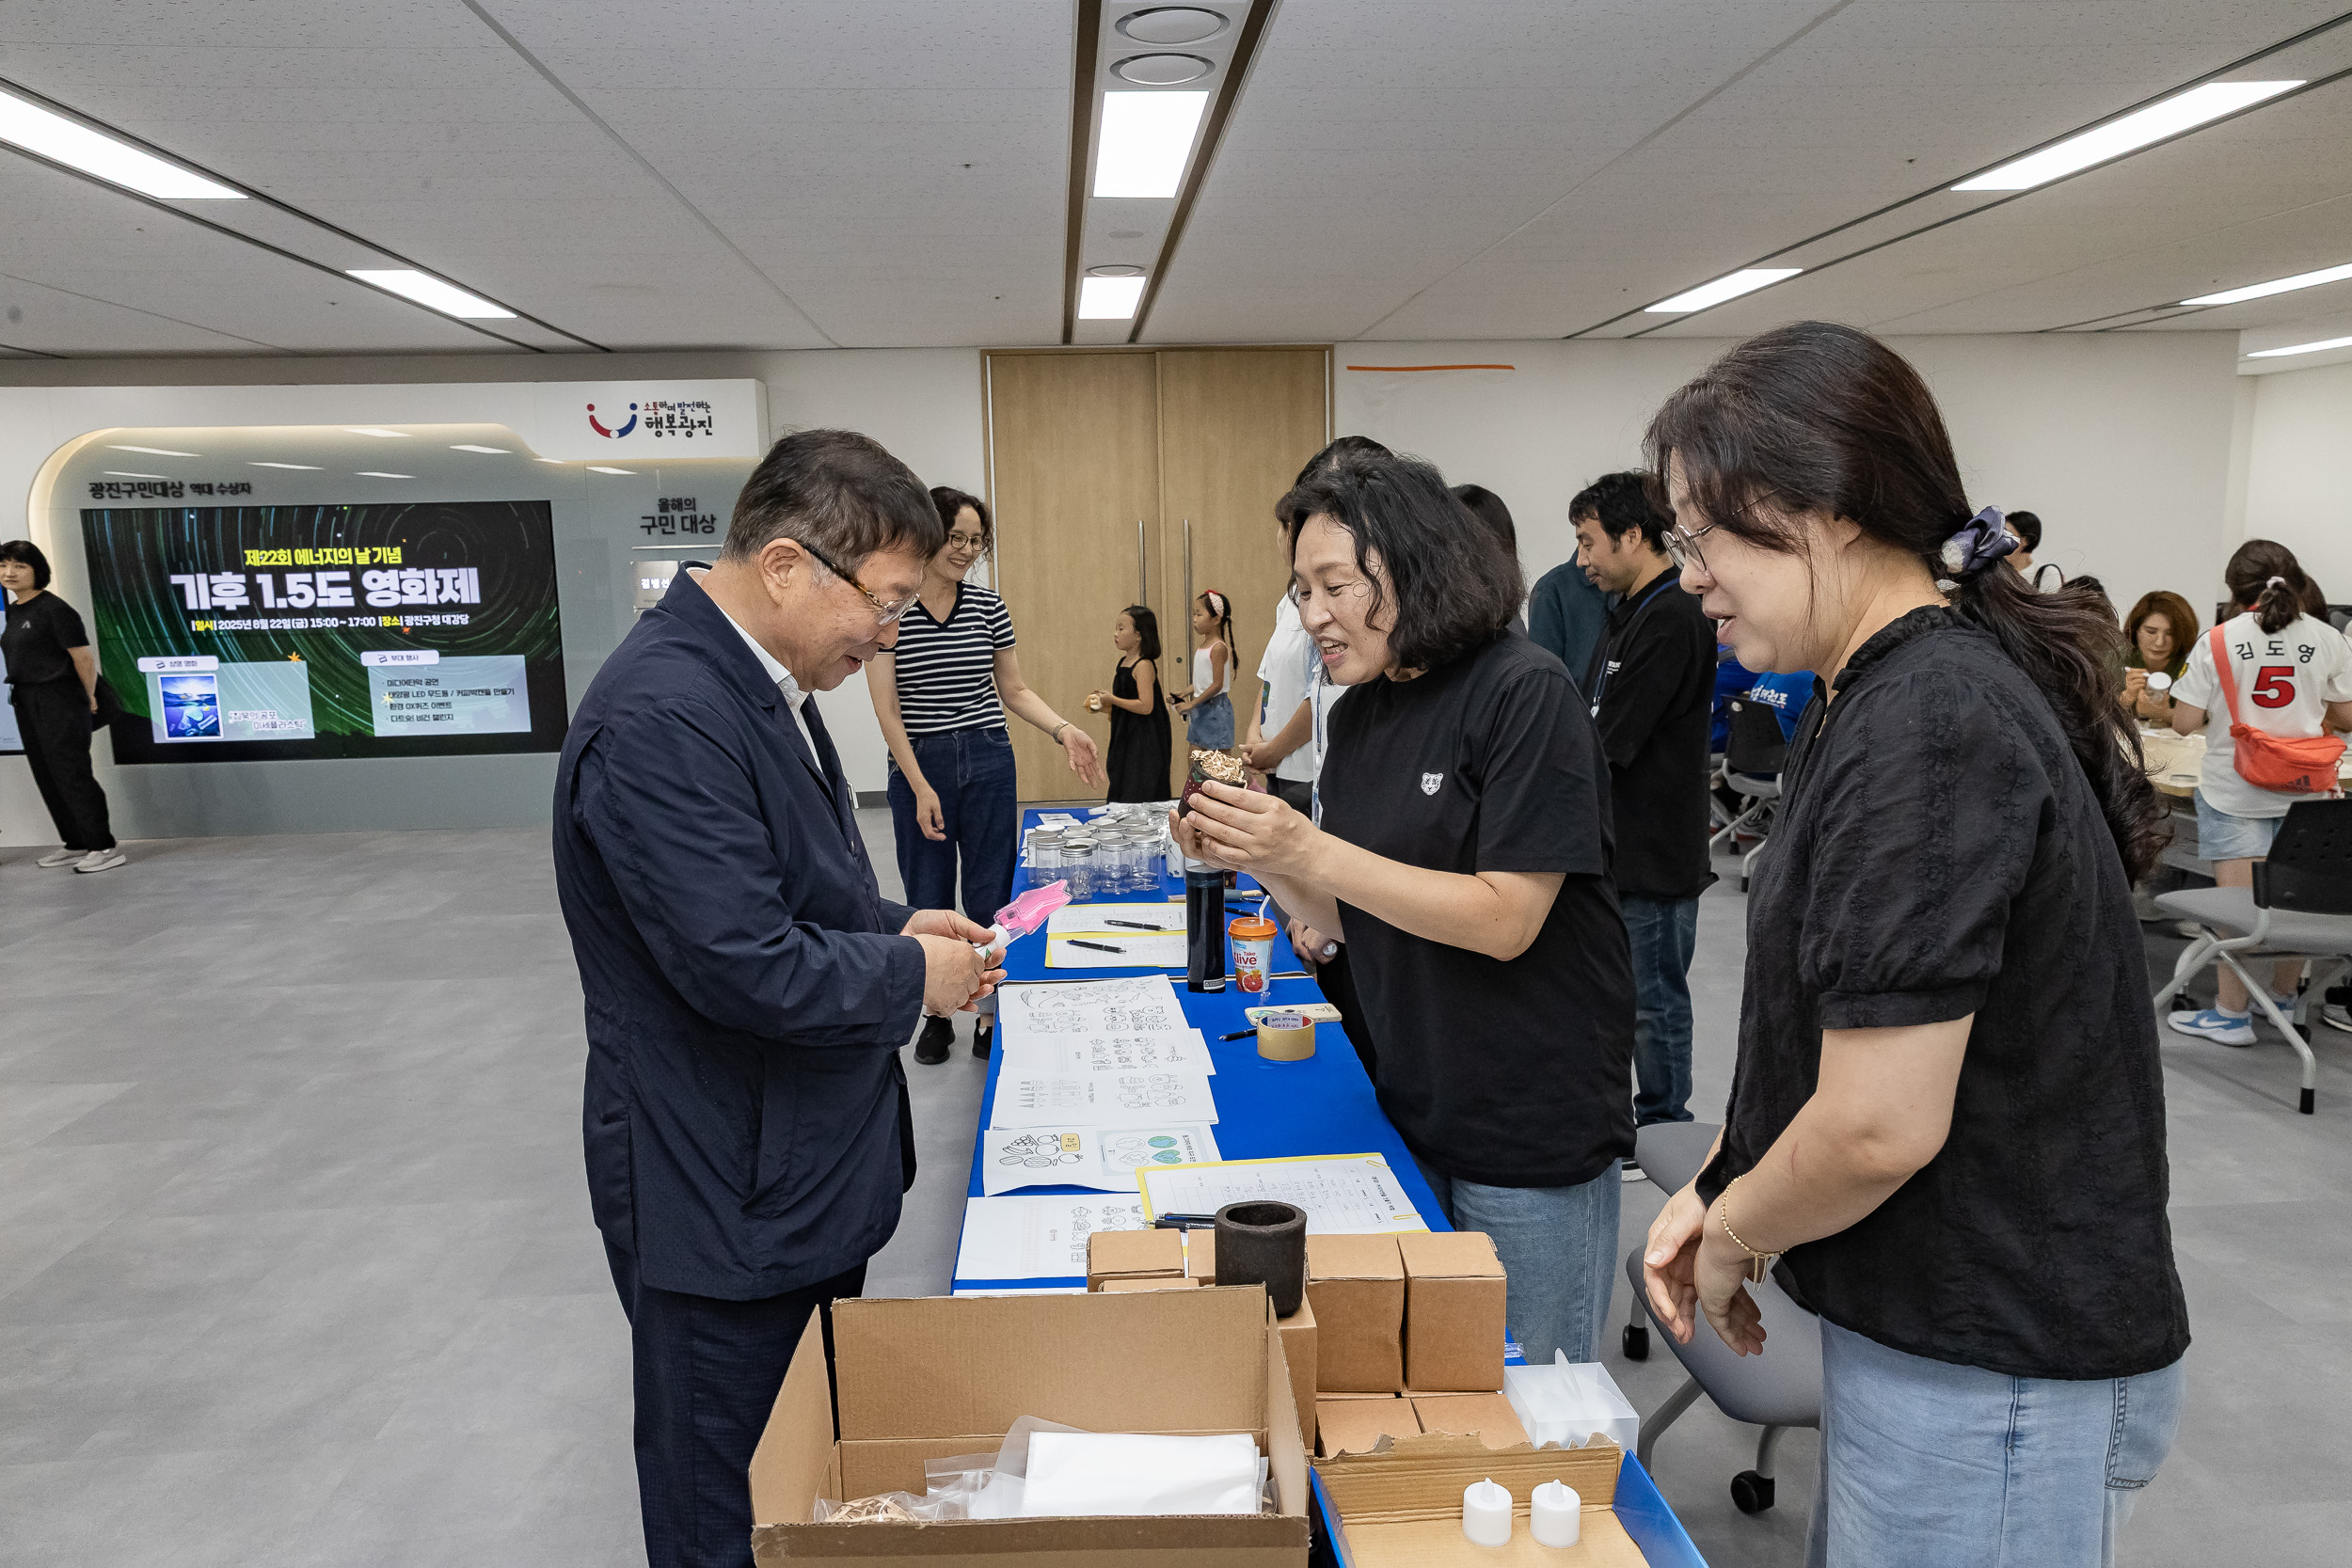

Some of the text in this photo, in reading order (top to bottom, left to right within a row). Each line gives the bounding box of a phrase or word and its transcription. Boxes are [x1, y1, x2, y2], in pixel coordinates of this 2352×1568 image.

[644, 401, 711, 416] 소통하며 발전하는
[644, 414, 713, 438] 행복광진
[88, 481, 252, 499] 광진구민대상 역대 수상자
[658, 497, 697, 513] 올해의
[640, 514, 716, 535] 구민 대상
[245, 546, 403, 566] 제22회 에너지의 날 기념
[170, 567, 481, 610] 기후 1.5도 영화제
[218, 619, 252, 630] 2025년
[253, 619, 270, 630] 8월
[270, 618, 309, 630] 22일(금)
[310, 617, 339, 628] 15:00
[348, 617, 376, 627] 17:00
[404, 615, 441, 626] 광진구청
[442, 614, 469, 626] 대강당
[2235, 641, 2315, 664] 김도영
[2251, 665, 2296, 709] 5
